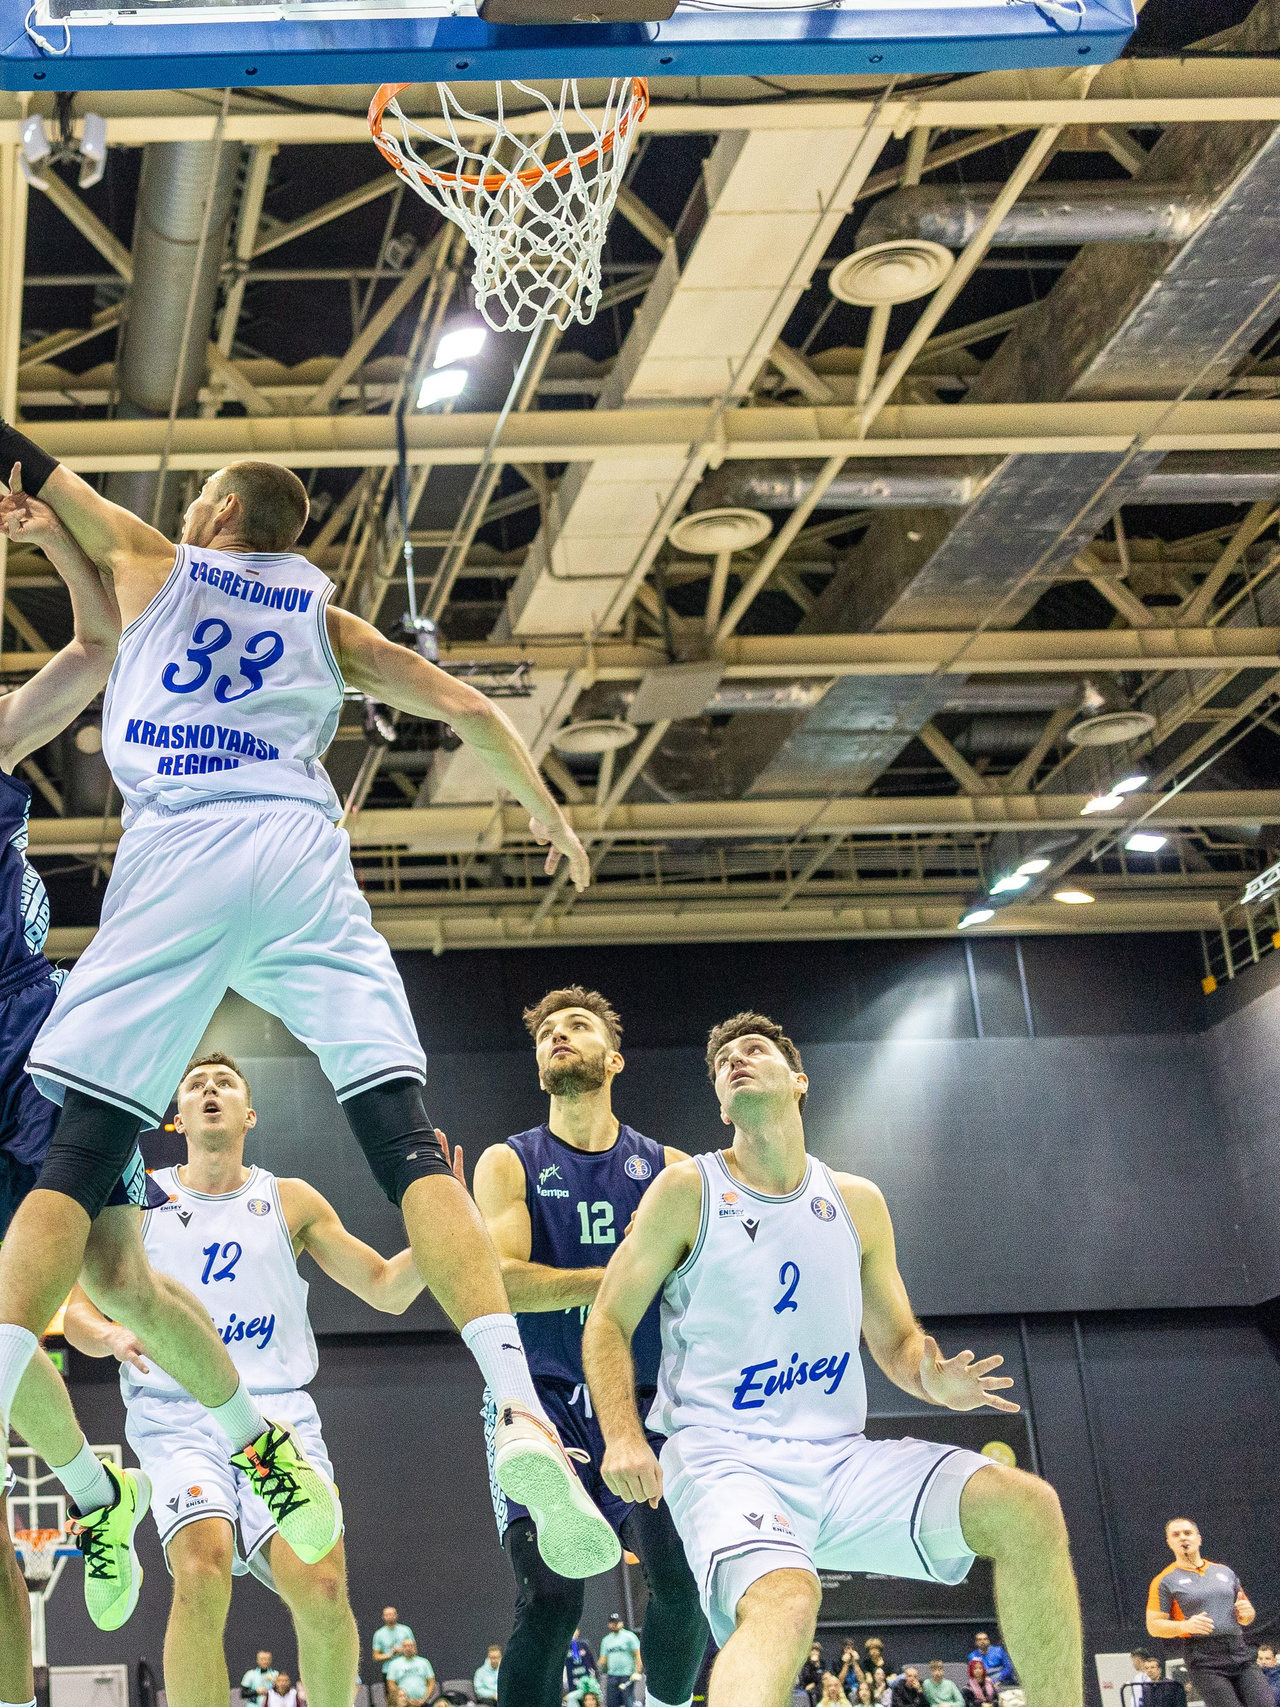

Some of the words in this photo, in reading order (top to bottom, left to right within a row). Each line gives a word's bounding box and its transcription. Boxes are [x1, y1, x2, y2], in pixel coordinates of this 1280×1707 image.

[189, 560, 314, 613] ZAGRETDINOV
[161, 618, 284, 704] 33
[157, 753, 239, 776] REGION
[577, 1201, 616, 1244] 12
[201, 1241, 242, 1285] 12
[773, 1261, 800, 1315] 2
[213, 1313, 275, 1349] isey
[732, 1352, 850, 1410] Enisey
